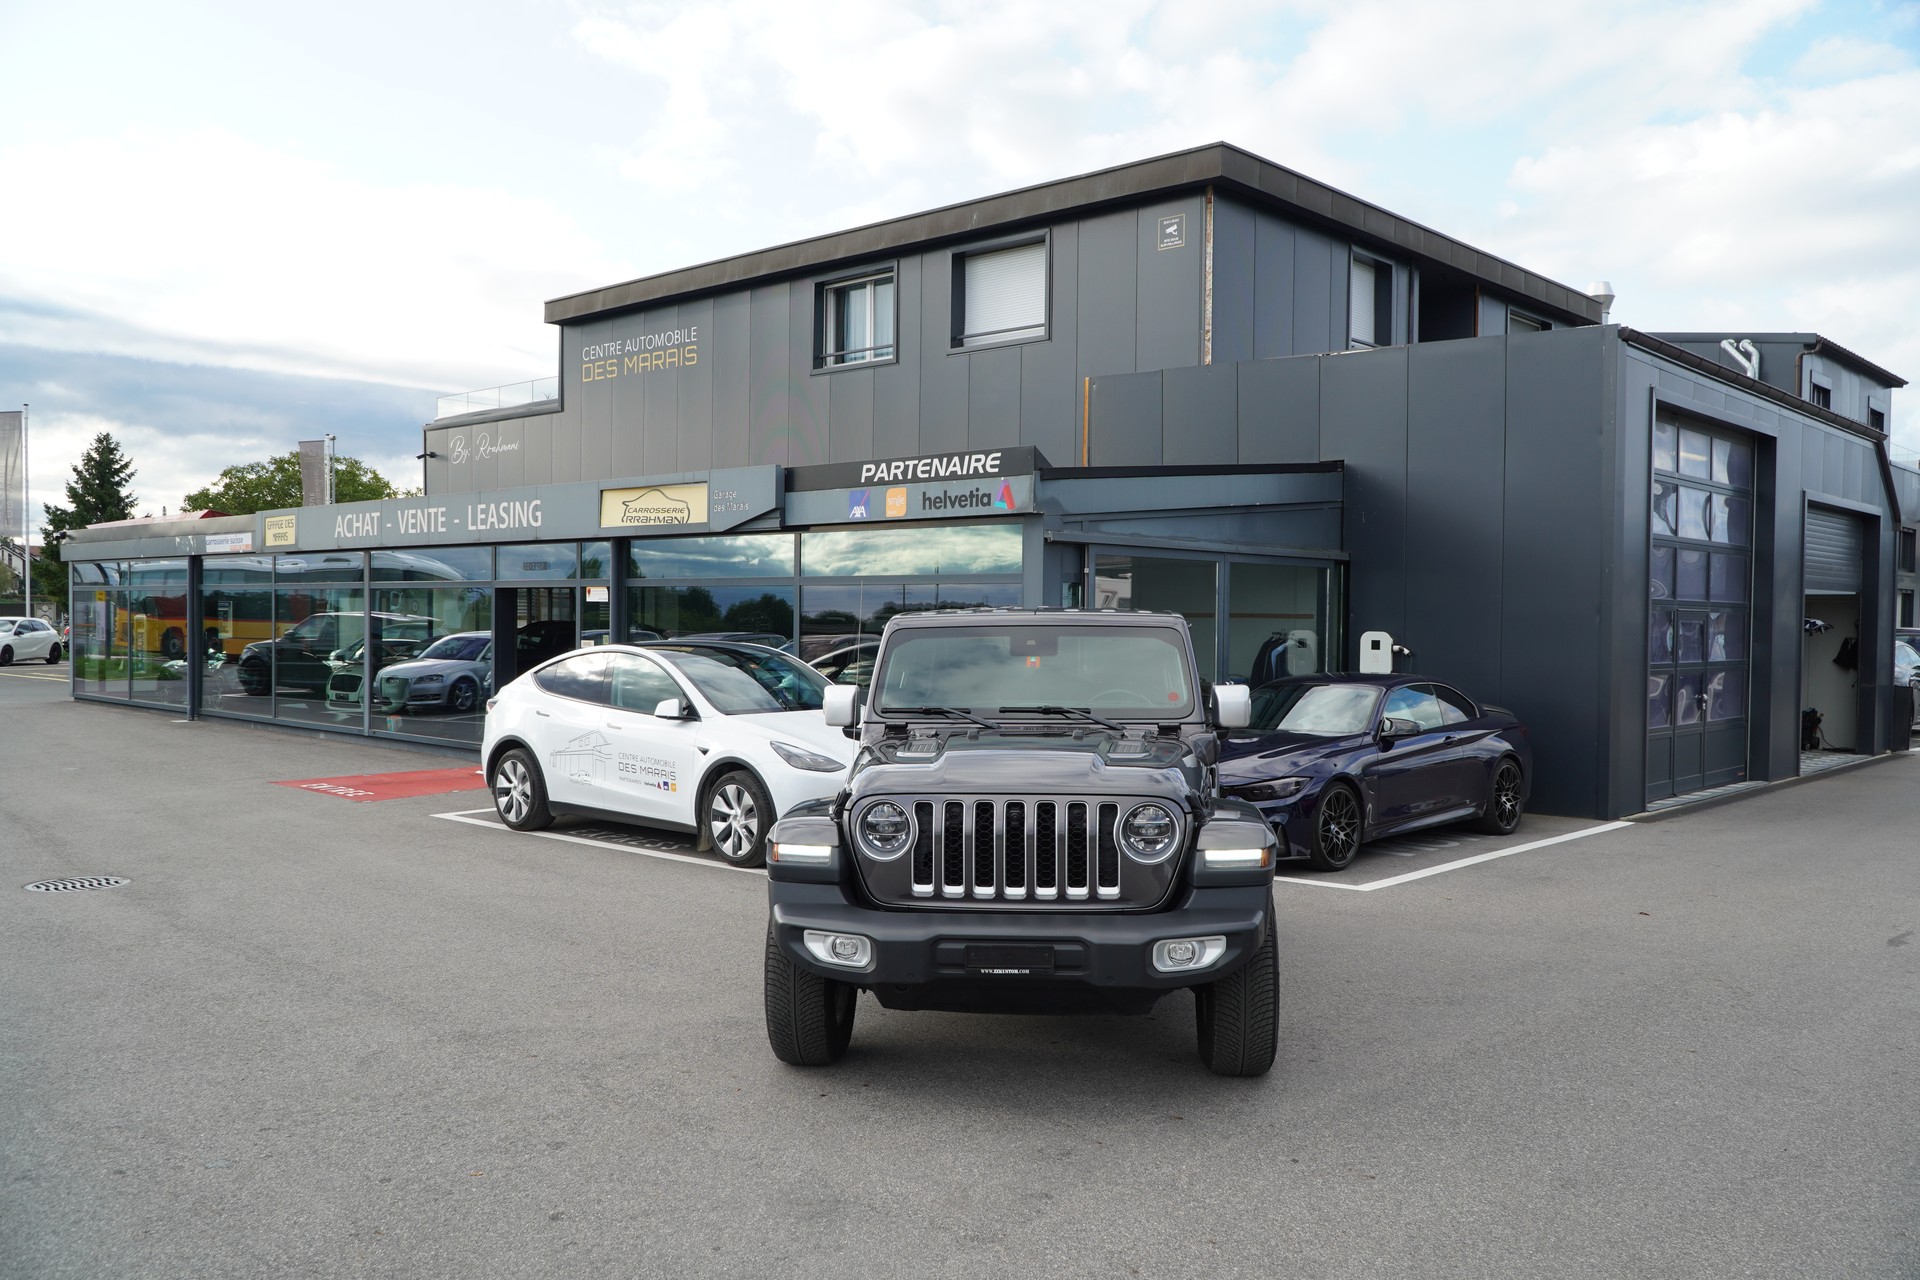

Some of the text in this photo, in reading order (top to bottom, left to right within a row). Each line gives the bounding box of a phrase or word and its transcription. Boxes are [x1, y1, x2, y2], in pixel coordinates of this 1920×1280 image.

[582, 326, 698, 361] CENTRE AUTOMOBILE
[582, 345, 698, 382] DES MARAIS
[860, 452, 1002, 483] PARTENAIRE
[713, 490, 737, 500] Garage
[922, 487, 992, 511] helvetia
[713, 503, 725, 512] des
[849, 505, 867, 518] AXA
[334, 511, 380, 538] ACHAT
[397, 507, 447, 534] VENTE
[467, 500, 542, 531] LEASING
[618, 752, 676, 769] CENTRE AUTOMOBILE
[618, 761, 677, 781] DES MARAIS
[569, 828, 692, 850] EXPRESS
